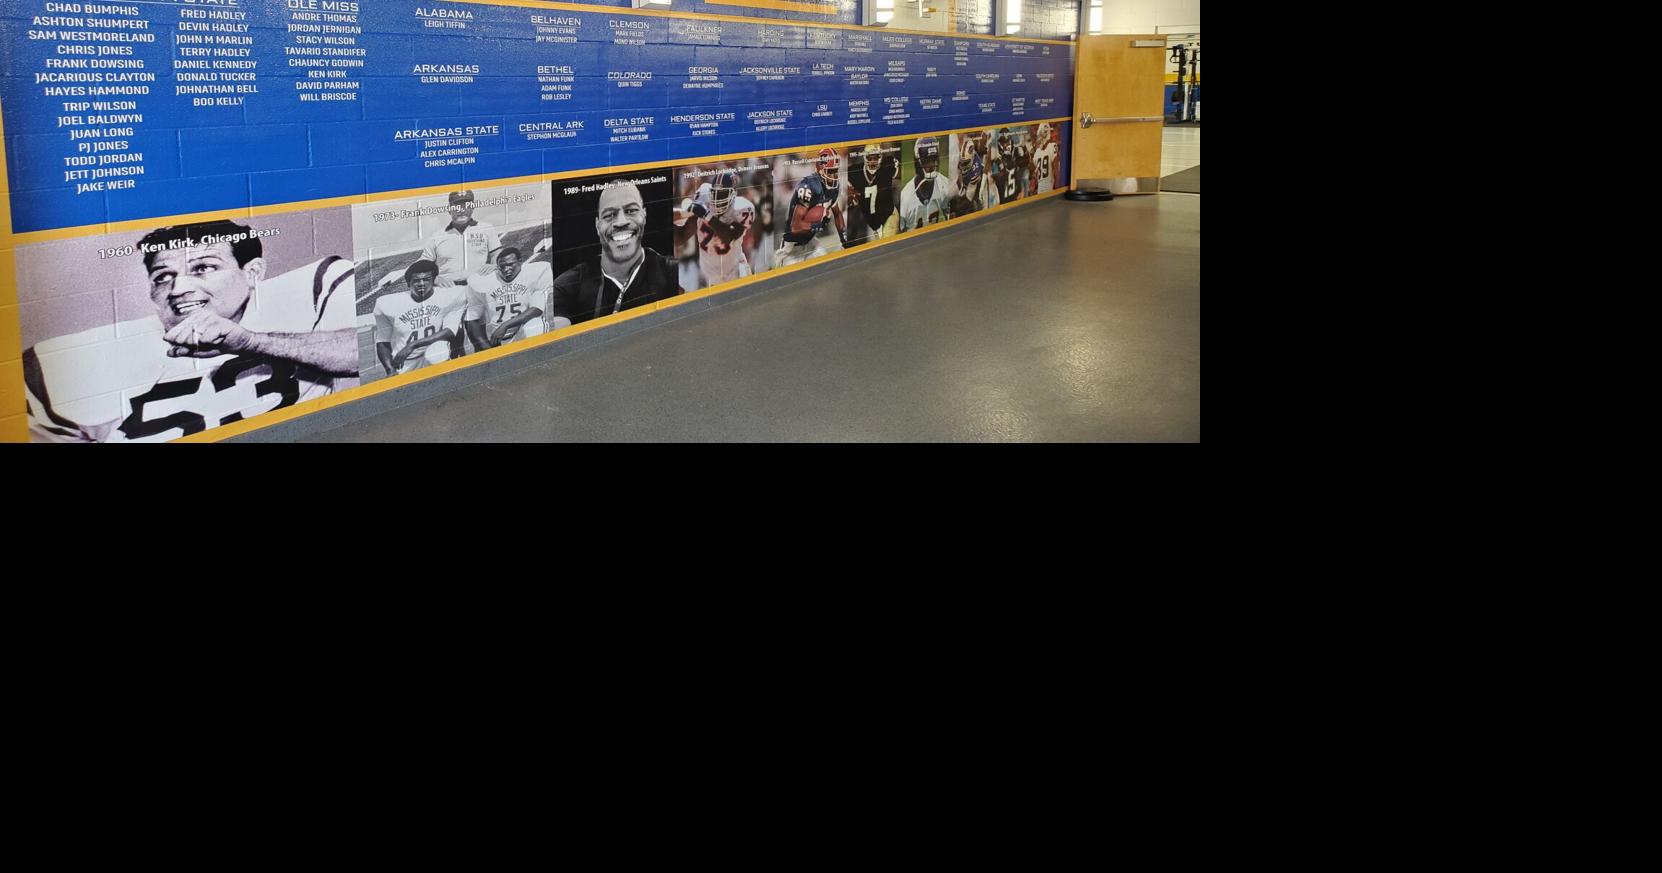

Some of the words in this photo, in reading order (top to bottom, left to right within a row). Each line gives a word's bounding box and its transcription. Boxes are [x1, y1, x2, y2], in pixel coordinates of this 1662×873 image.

[46, 3, 81, 13] CHAD
[84, 4, 139, 15] BUMPHIS
[289, 0, 318, 10] OLE
[323, 1, 358, 11] MISS
[181, 10, 206, 19] FRED
[209, 11, 246, 20] HADLEY
[292, 13, 320, 22] ANDRE
[323, 14, 356, 22] THOMAS
[415, 8, 473, 19] ALABAMA
[33, 16, 83, 27] ASHTON
[87, 18, 149, 29] SHUMPERT
[531, 16, 581, 25] BELHAVEN
[610, 20, 649, 28] CLEMSON
[179, 22, 209, 32] DEVIN
[212, 24, 248, 32] HADLEY
[288, 24, 320, 33] JORDAN
[323, 25, 361, 34] JERNIGAN
[29, 30, 56, 40] SAM
[60, 32, 154, 42] WESTMORELAND
[176, 35, 202, 44] JOHN
[216, 36, 252, 44] MARLIN
[57, 46, 95, 54] CHRIS
[98, 46, 133, 56] JONES
[180, 48, 211, 56] TERRY
[214, 49, 250, 57] HADLEY
[285, 47, 320, 55] TAVARIO
[46, 60, 87, 68] FRANK
[91, 60, 144, 68] DOWSING
[175, 60, 210, 69] DANIEL
[213, 60, 257, 68] KENNEDY
[414, 65, 479, 73] ARKANSAS
[35, 73, 102, 84] JACARIOUS
[106, 73, 155, 81] CLAYTON
[177, 73, 217, 81] DONALD
[45, 87, 85, 95] HAYES
[89, 86, 149, 94] HAMMOND
[176, 86, 234, 95] JOHNATHAN
[217, 97, 244, 105] KELLY
[63, 103, 90, 111] TRIP
[93, 102, 136, 110] WILSON
[58, 116, 85, 126] JOEL
[88, 115, 142, 124] BALDWYN
[671, 114, 714, 122] HENDERSON
[519, 123, 563, 132] CENTRAL
[71, 129, 100, 139] JUAN
[104, 128, 133, 137] LONG
[395, 128, 462, 140] ARKANSAS
[466, 126, 499, 134] STATE
[79, 143, 90, 152] PJ
[94, 141, 128, 152] JONES
[425, 140, 447, 148] JUSTIN
[438, 147, 478, 157] CARRINGTON
[64, 157, 96, 166] TODD
[99, 154, 142, 165] JORDAN
[447, 157, 475, 166] MCALPIN
[64, 170, 89, 181] JETT
[92, 166, 144, 179] JOHNSON
[77, 183, 104, 194] JAKE
[107, 180, 135, 190] WEIR
[865, 185, 877, 214] 7
[401, 209, 424, 218] Frank
[465, 197, 512, 209] Philadelphia
[513, 194, 535, 202] Eagles
[141, 242, 165, 253] Ken
[169, 238, 198, 249] Kirk,
[201, 232, 247, 246] Chicago
[249, 227, 280, 238] Bears
[490, 282, 528, 299] MISSISSIPPI
[499, 294, 518, 303] STATE
[400, 304, 441, 323] MISSISSIPPI
[496, 303, 522, 323] 75
[410, 317, 432, 329] STATE
[117, 353, 300, 439] 53
